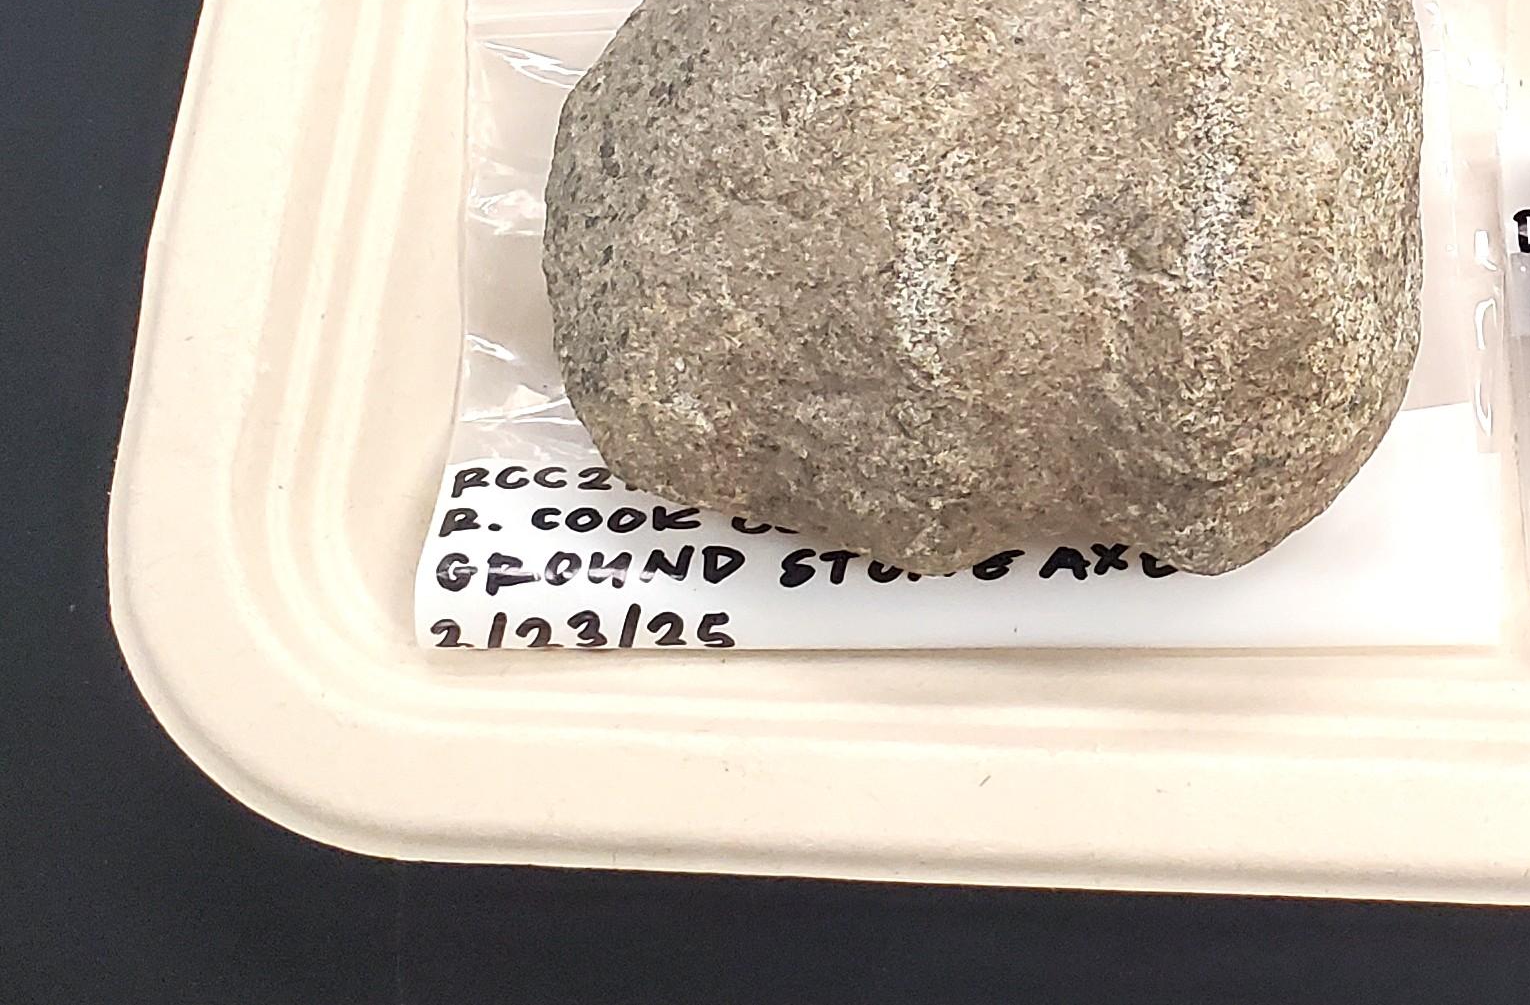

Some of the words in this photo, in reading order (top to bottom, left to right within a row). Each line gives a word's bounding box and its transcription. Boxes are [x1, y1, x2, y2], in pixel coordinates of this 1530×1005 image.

[452, 466, 645, 498] RCC2
[439, 507, 503, 537] R.
[531, 505, 702, 534] COOK
[435, 545, 746, 596] GROUND
[779, 548, 1026, 588] STOE
[430, 602, 736, 648] 2/23/25
